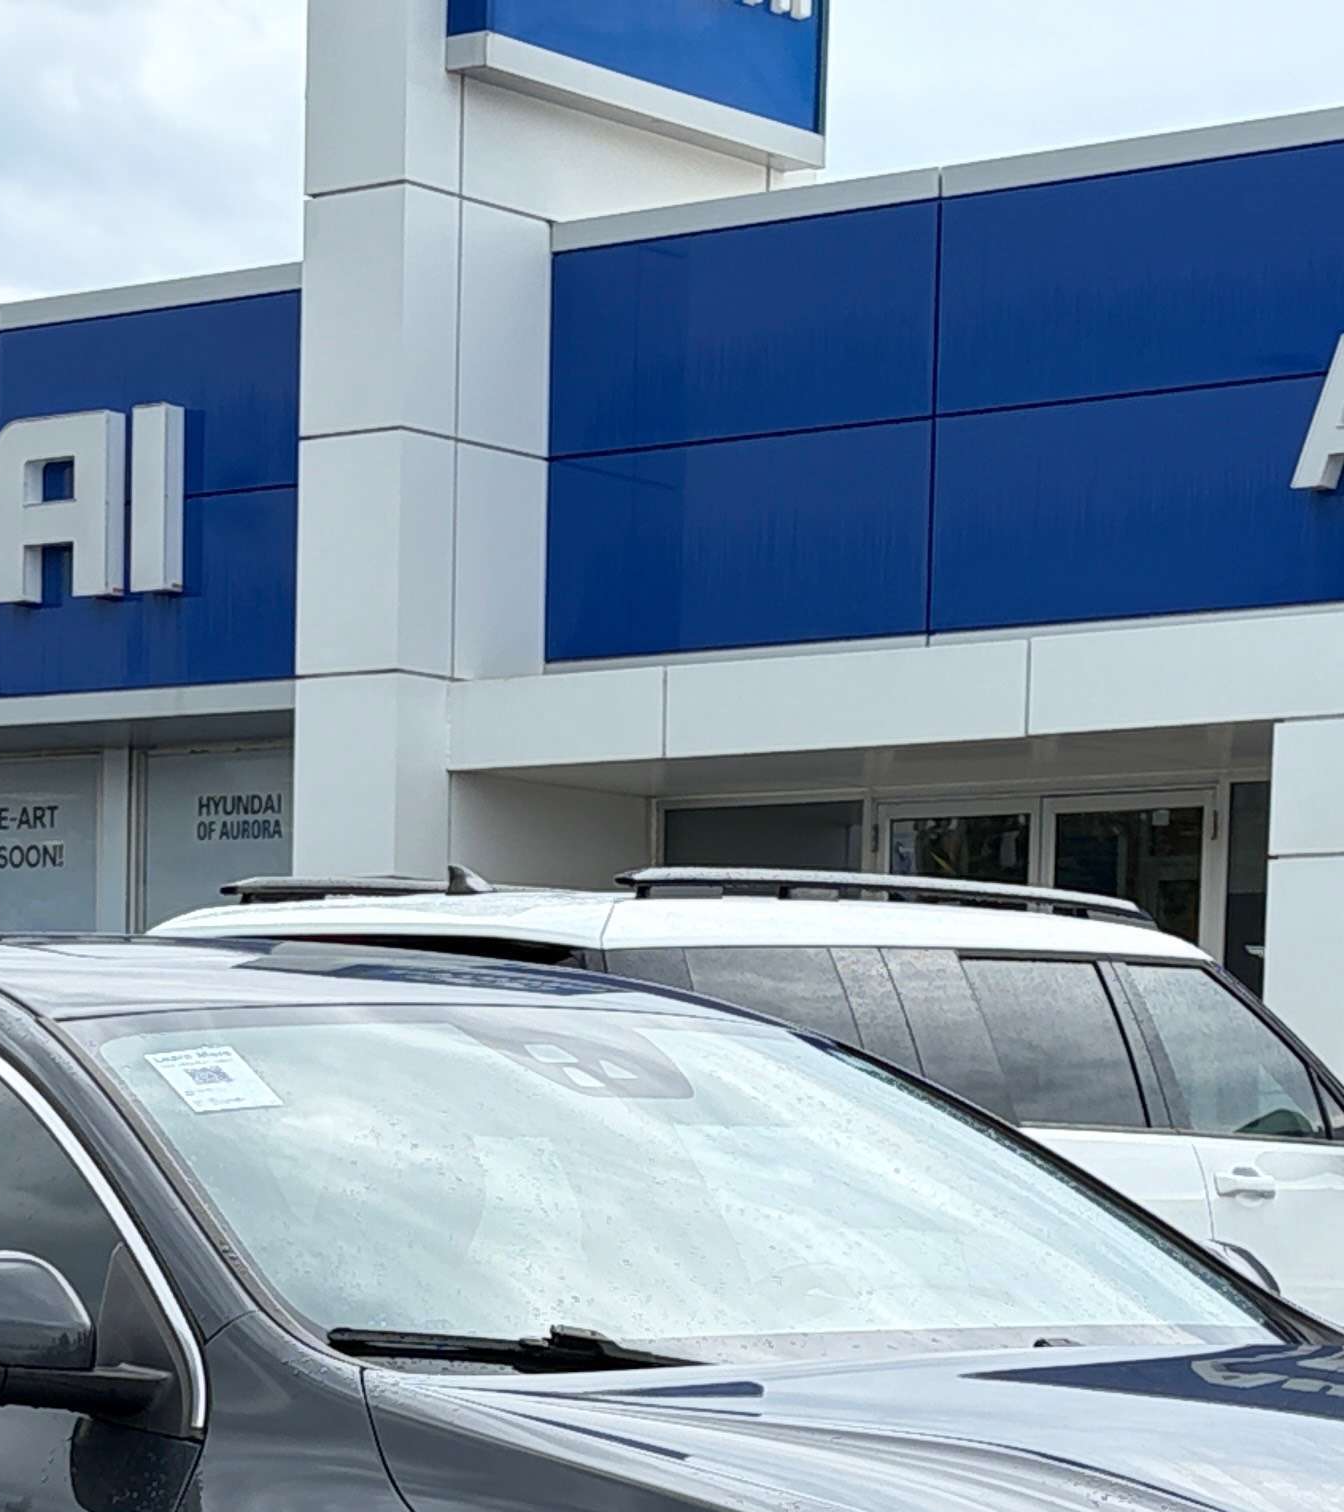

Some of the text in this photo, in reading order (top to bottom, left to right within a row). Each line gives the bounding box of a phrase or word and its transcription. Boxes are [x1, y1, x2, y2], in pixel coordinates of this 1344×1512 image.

[197, 794, 282, 817] HYUNDAI
[197, 819, 283, 840] OF AURORA
